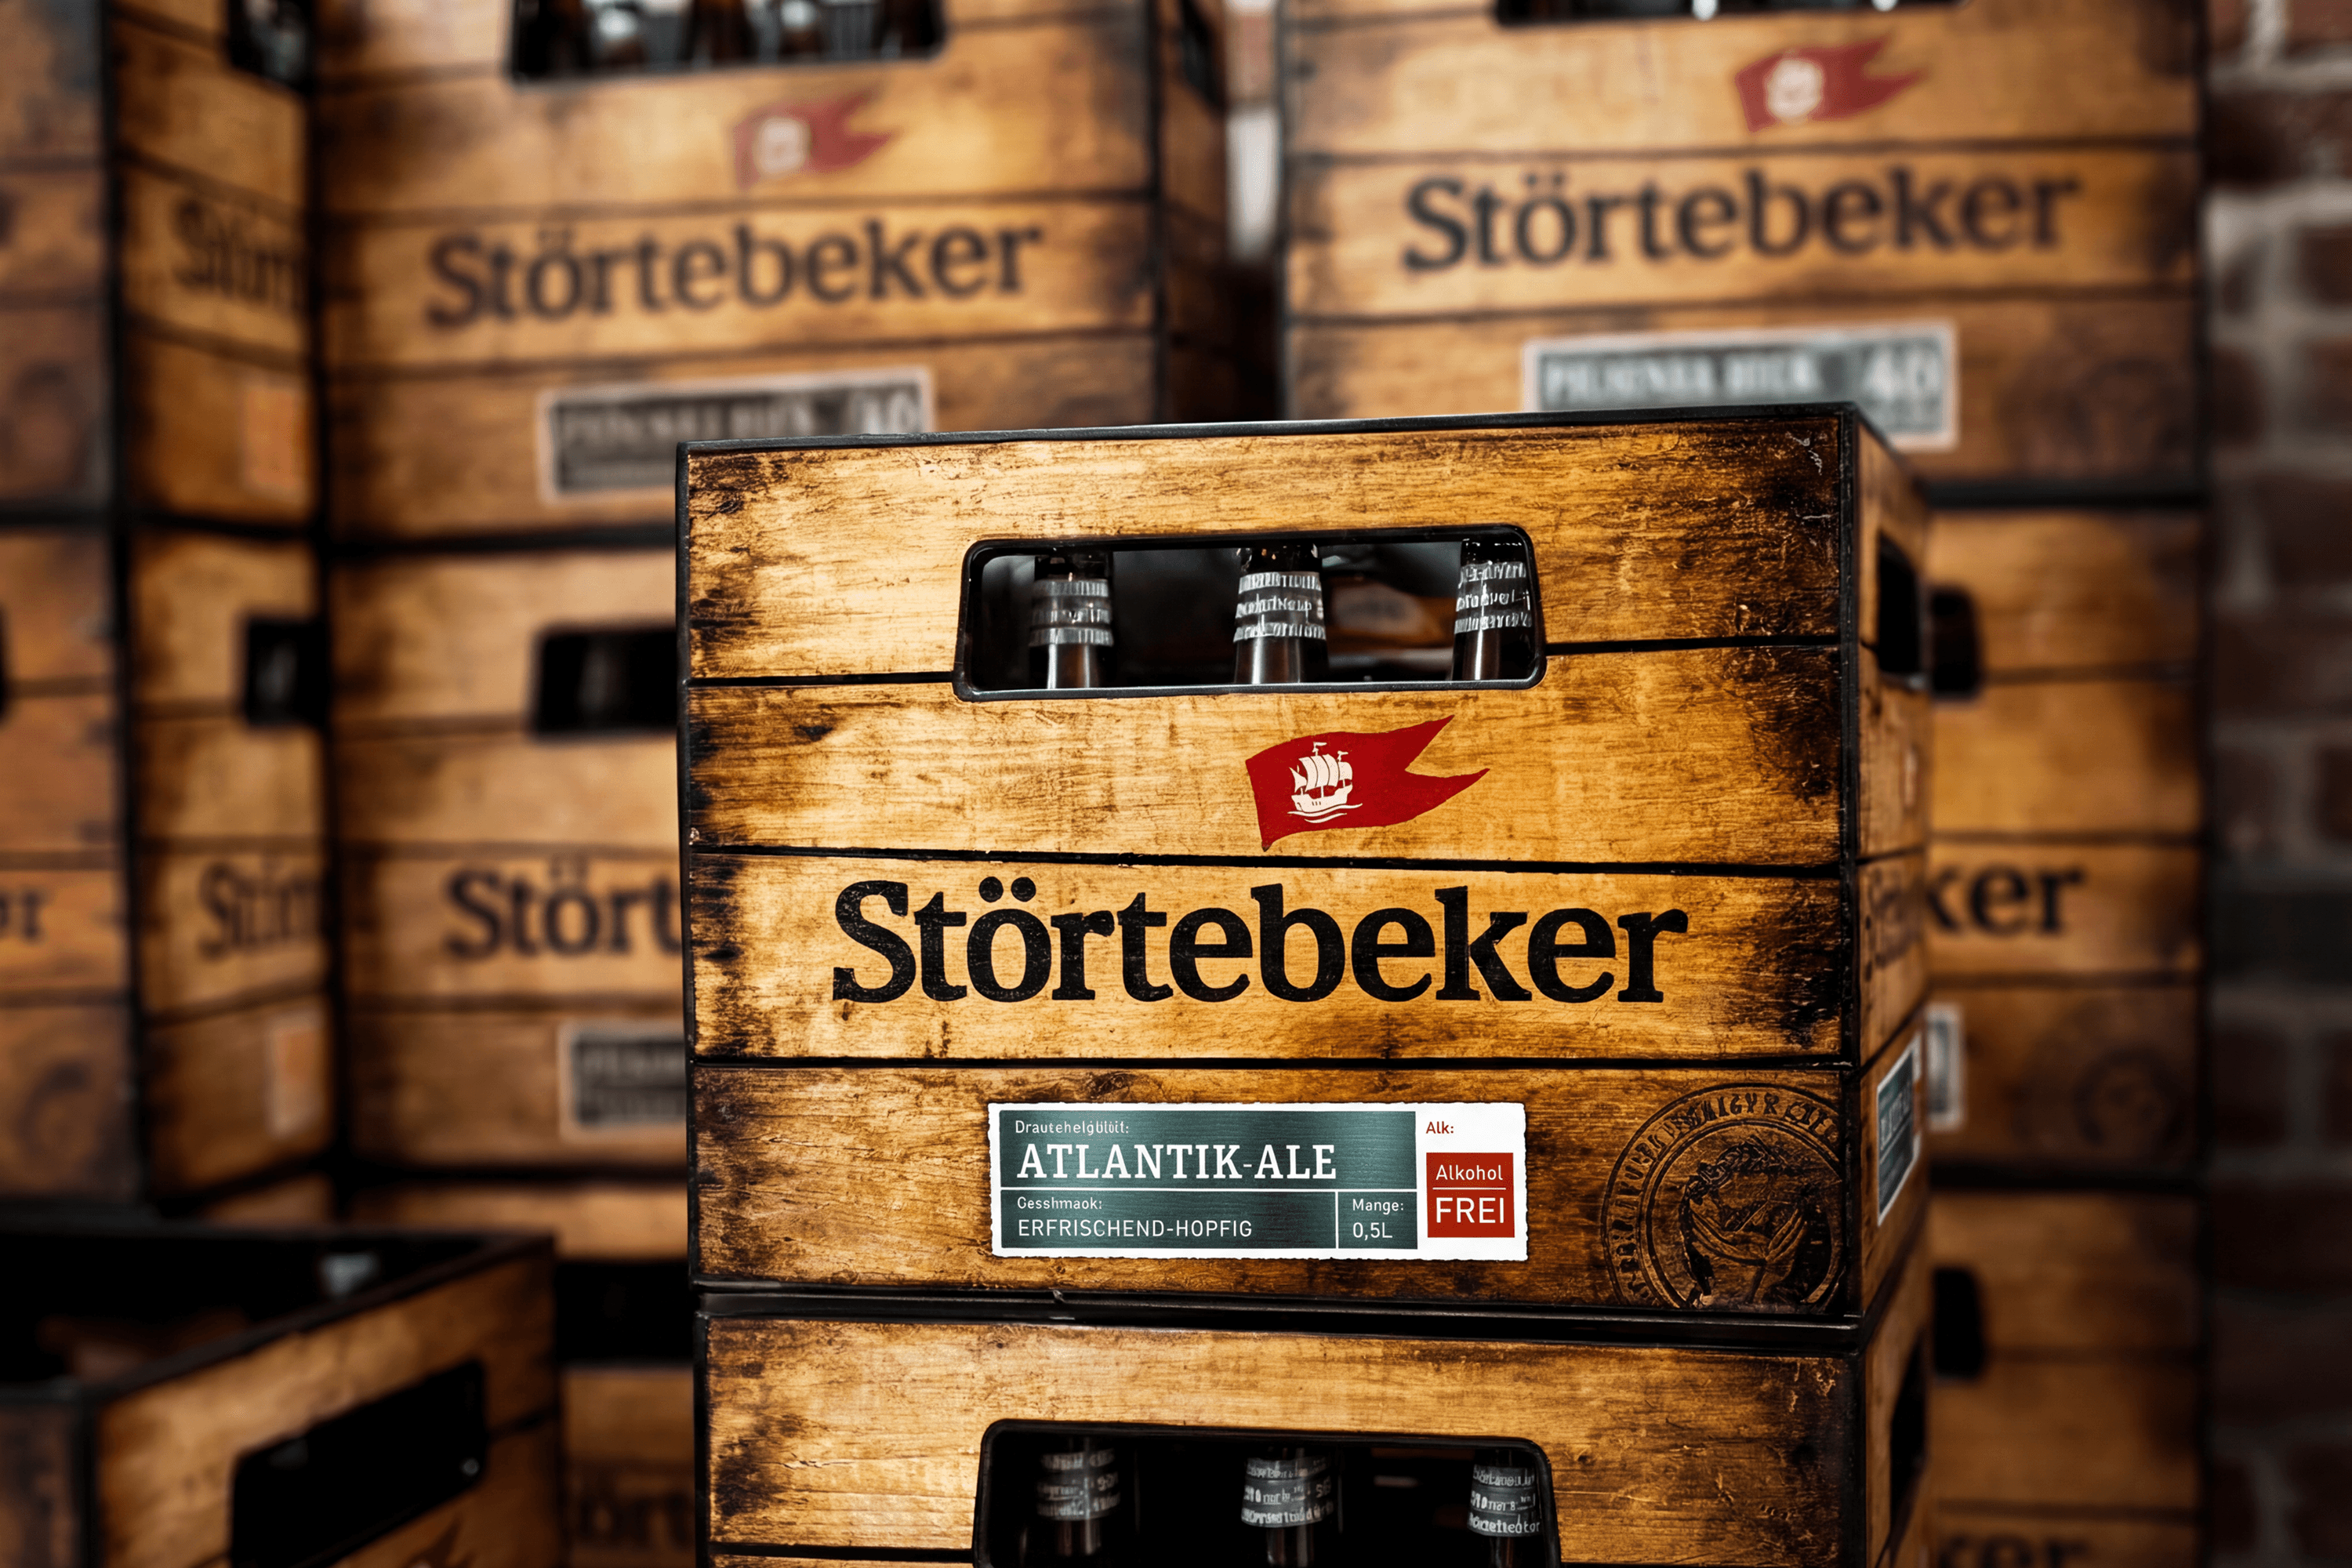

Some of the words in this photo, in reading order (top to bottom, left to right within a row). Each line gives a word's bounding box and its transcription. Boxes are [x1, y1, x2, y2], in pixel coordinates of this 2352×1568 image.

[1403, 163, 2080, 273] Störtebeker
[425, 217, 1041, 328] Störtebeker
[832, 875, 1689, 1004] Störtebeker
[1425, 1120, 1455, 1135] Alk:
[1017, 1143, 1337, 1179] ATLANTIK-ALE
[1436, 1164, 1504, 1181] Alkohol
[1352, 1198, 1405, 1215] Mange:
[1436, 1197, 1504, 1224] FREI
[1018, 1219, 1252, 1237] ERFRISCHEND-HOPFIG
[1352, 1221, 1393, 1240] 0,5L
